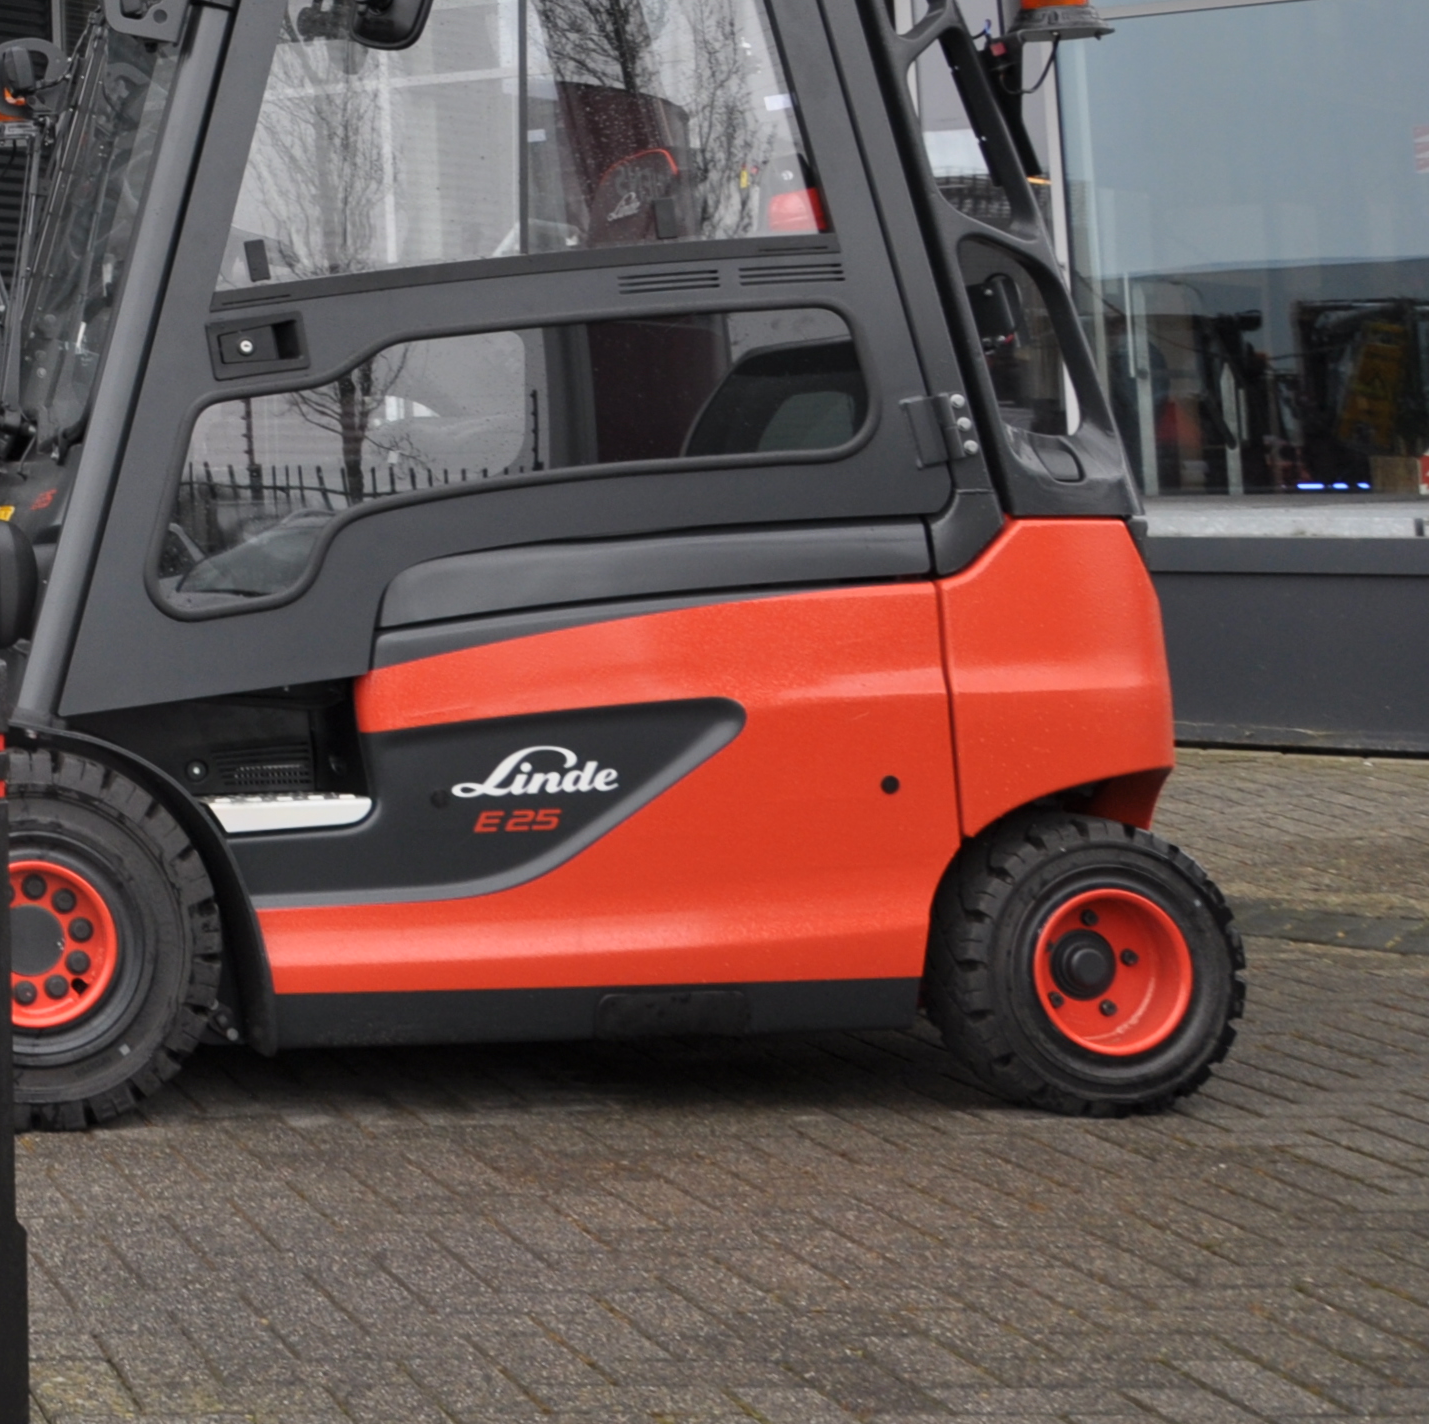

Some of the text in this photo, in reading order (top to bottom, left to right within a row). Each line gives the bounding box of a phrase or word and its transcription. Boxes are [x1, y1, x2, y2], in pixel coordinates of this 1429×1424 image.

[451, 745, 619, 799] Linde
[473, 807, 562, 833] E 25
